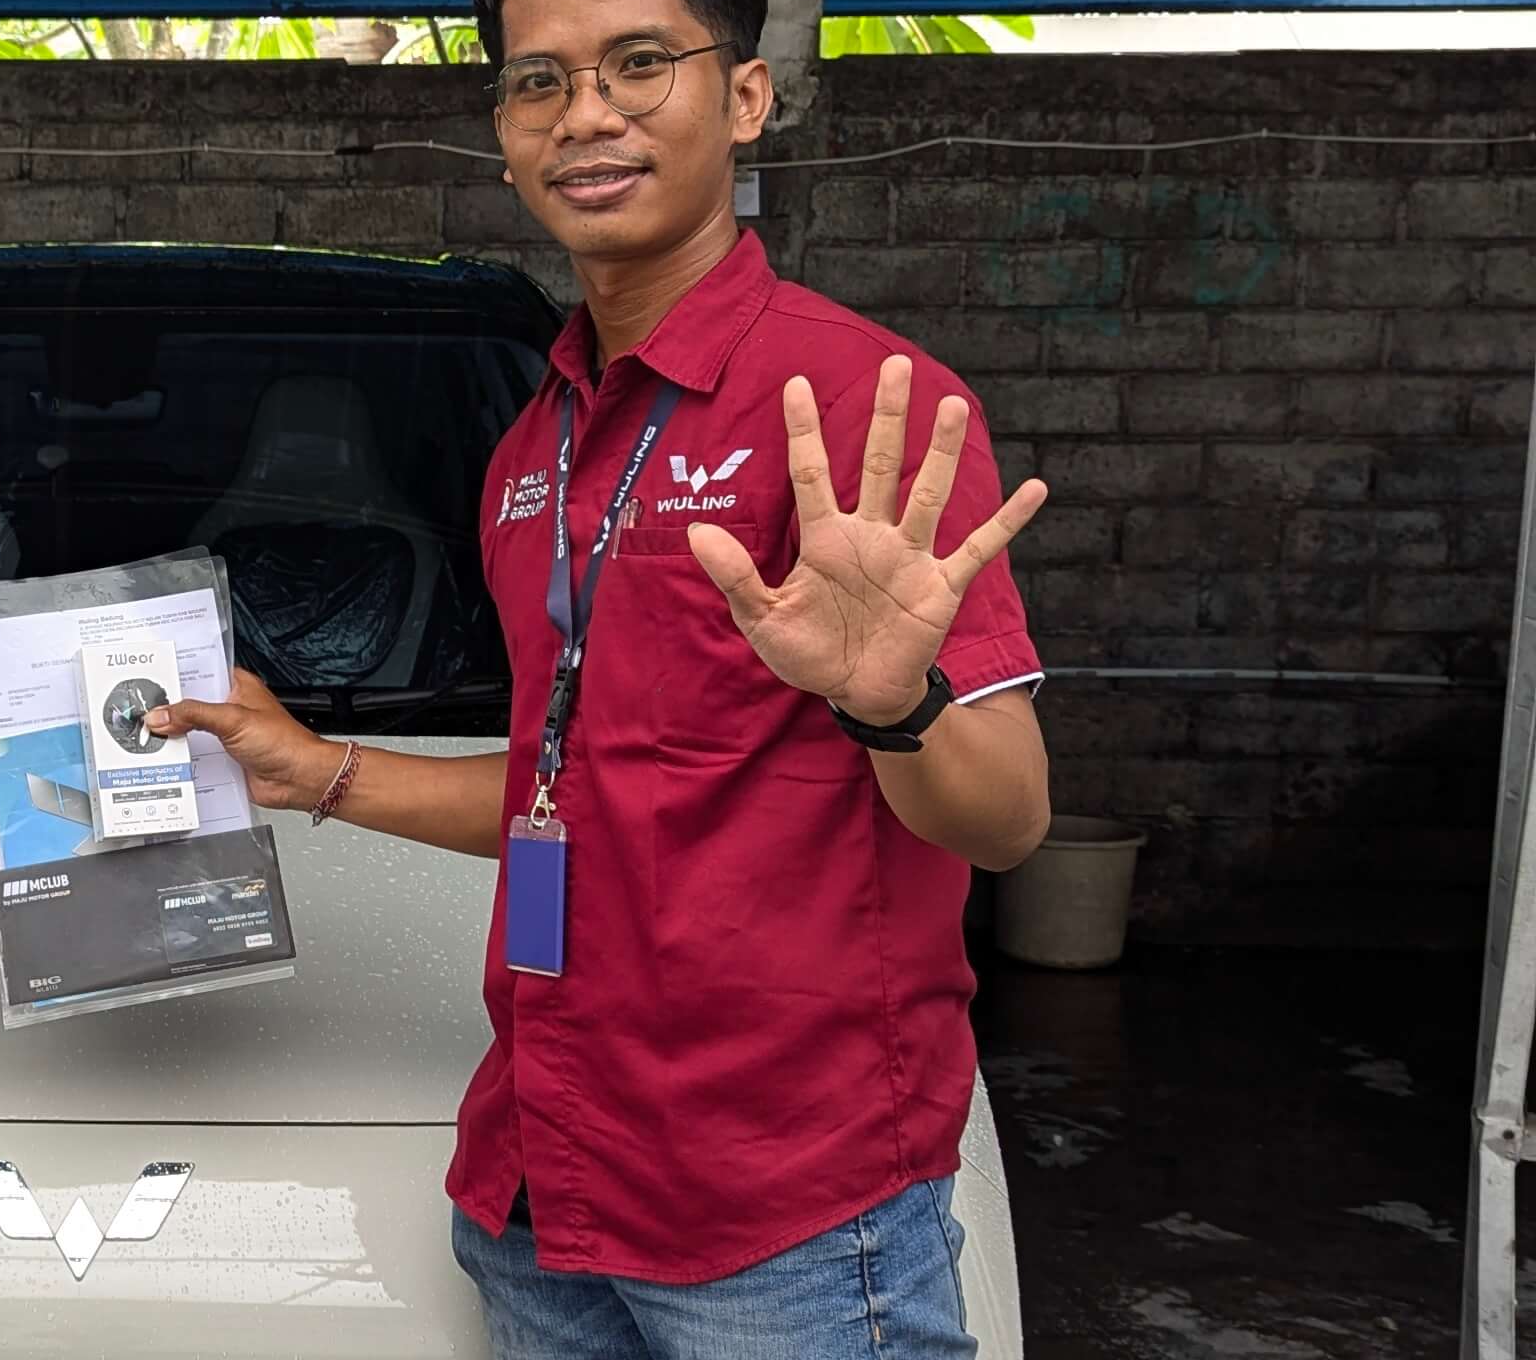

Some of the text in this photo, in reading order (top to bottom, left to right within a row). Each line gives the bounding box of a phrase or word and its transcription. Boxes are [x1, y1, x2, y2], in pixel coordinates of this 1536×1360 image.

[614, 425, 657, 508] WULING
[519, 469, 547, 488] MAJU
[514, 484, 550, 504] MOTOR
[657, 494, 737, 513] WULING
[510, 500, 546, 520] GROUP
[29, 874, 70, 892] MCLUB
[181, 895, 207, 906] MCLUB
[29, 975, 62, 989] BIG
